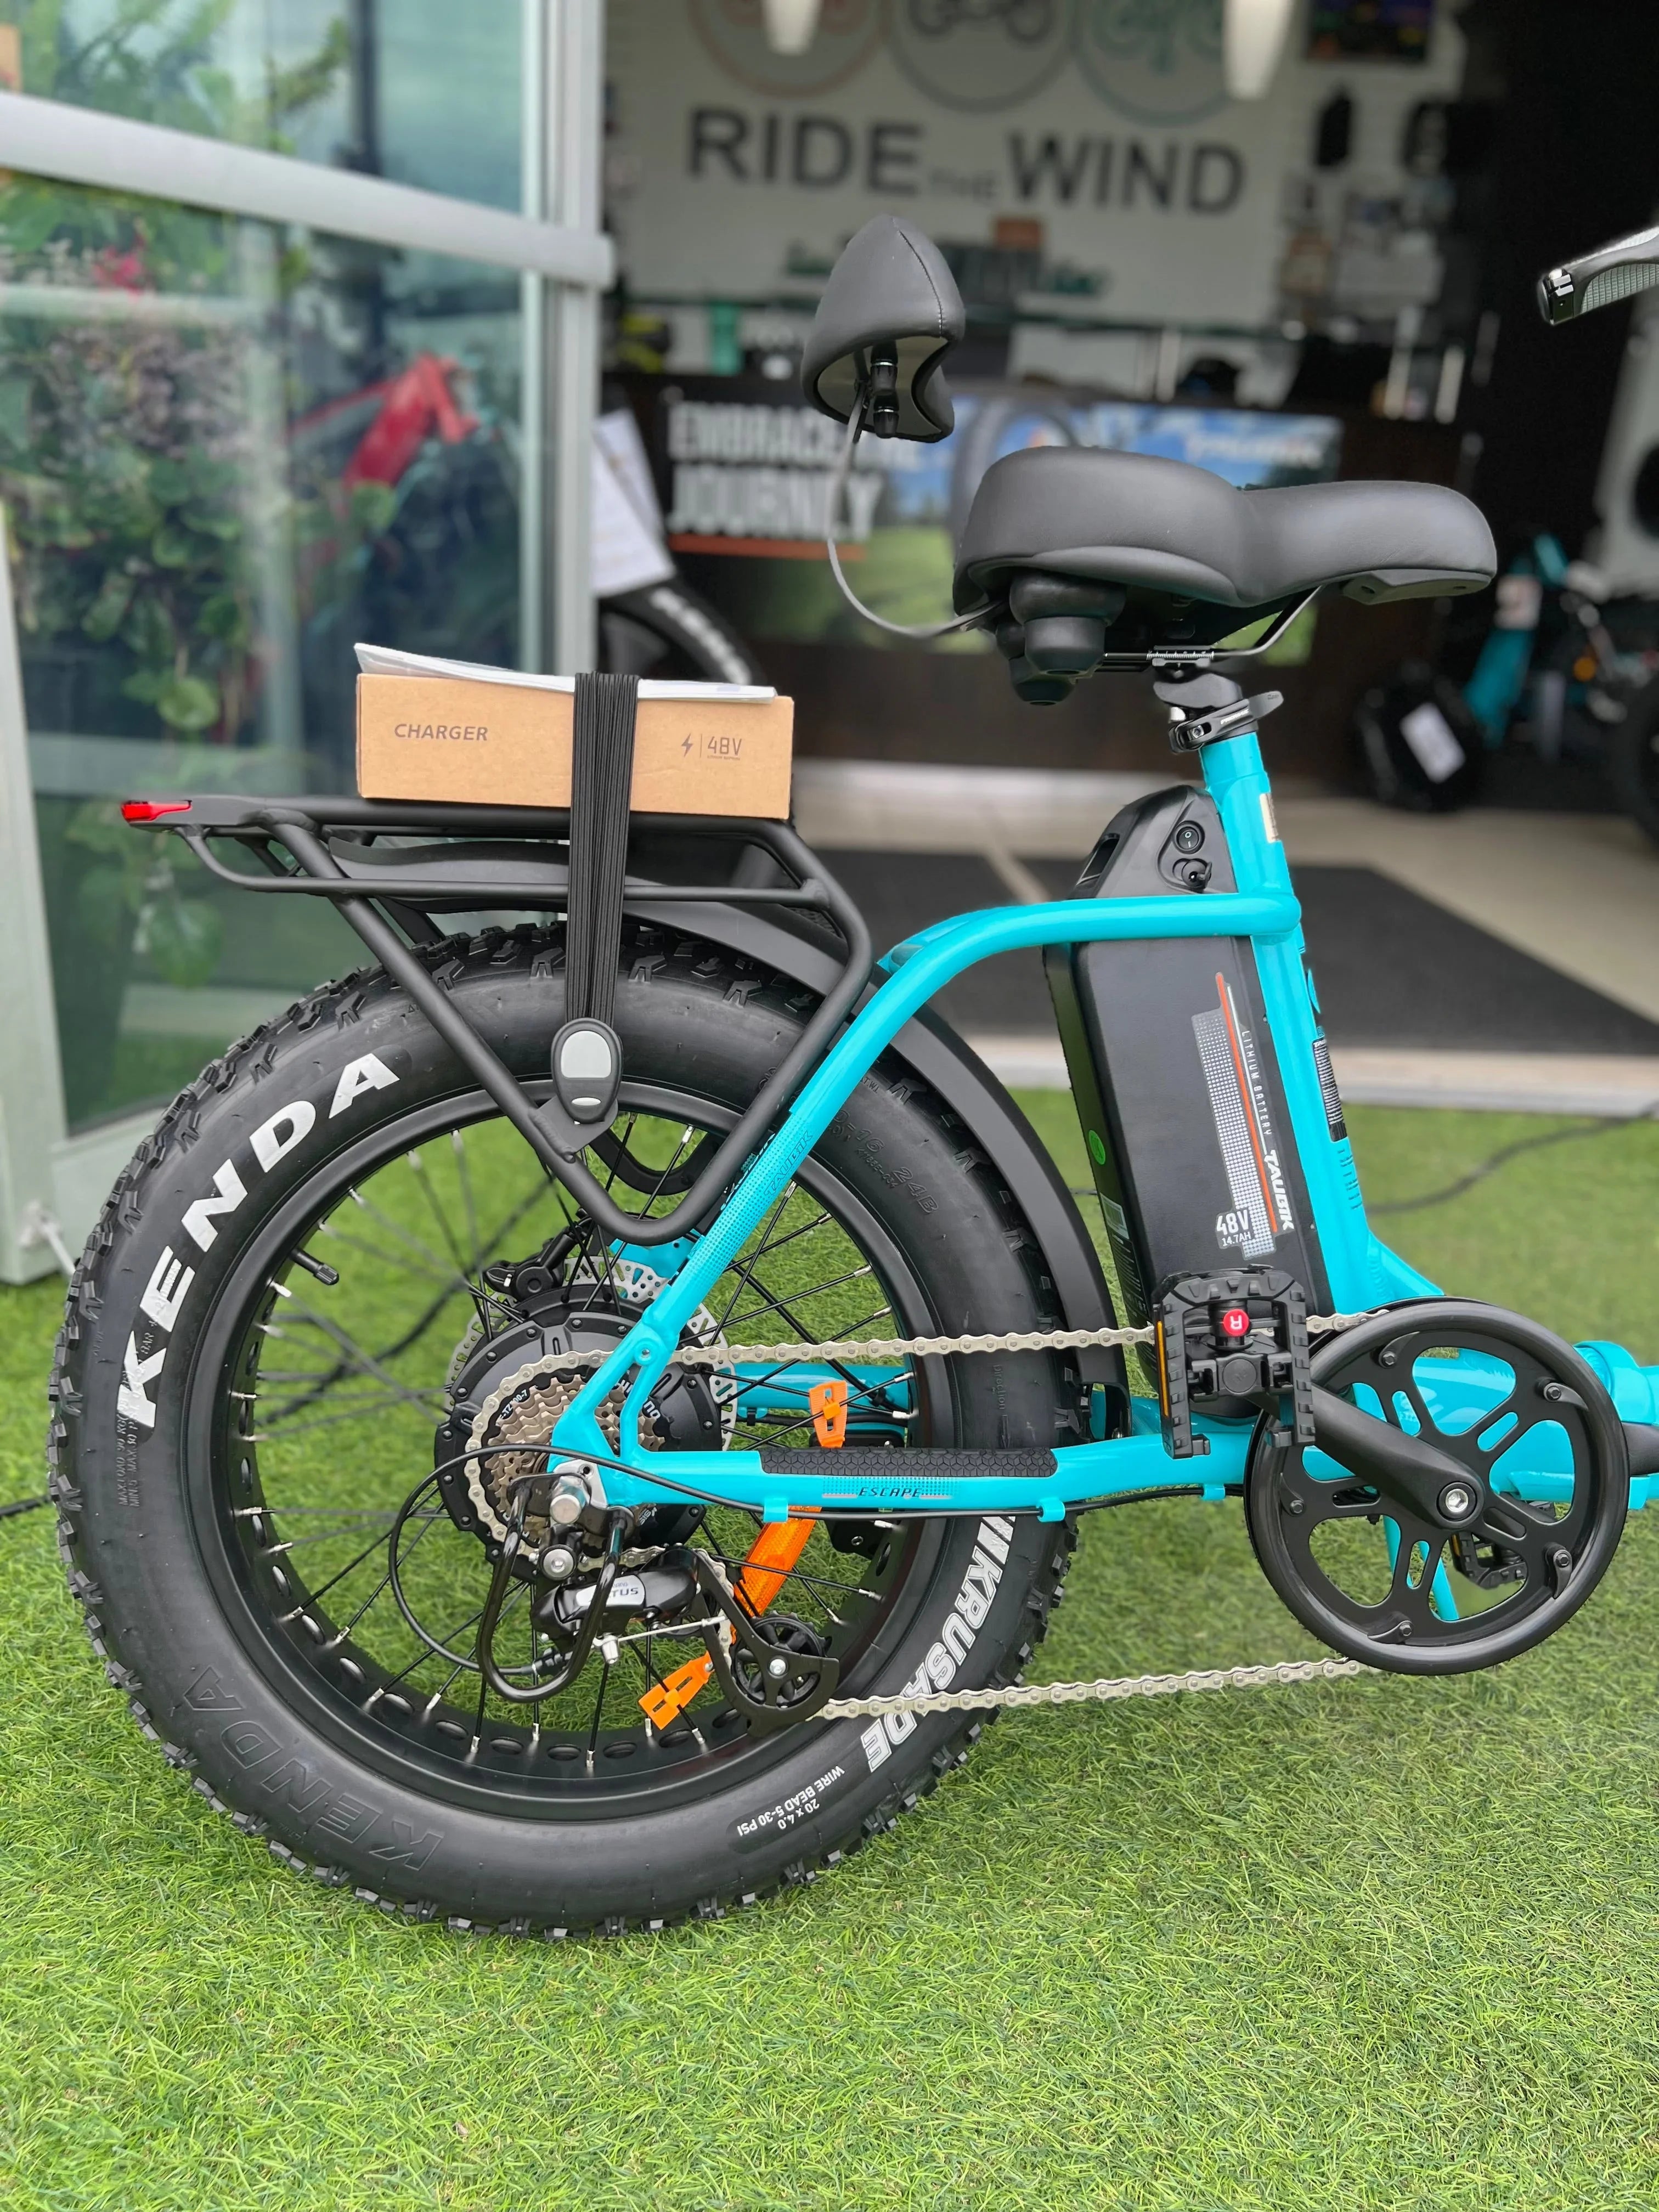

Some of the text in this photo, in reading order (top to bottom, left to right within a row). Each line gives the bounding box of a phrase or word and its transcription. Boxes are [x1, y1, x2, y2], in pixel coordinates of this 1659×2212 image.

[687, 105, 925, 198] RIDE
[1006, 131, 1247, 214] WIND
[394, 724, 742, 755] CHARGER 48V
[1241, 1030, 1272, 1136] LITHIUM BATTERY
[892, 1166, 939, 1214] 24B
[1216, 1209, 1250, 1235] 48V
[117, 1053, 400, 1427] KENDA
[1221, 1231, 1251, 1246] 14.7AH
[1229, 1314, 1243, 1330] R
[858, 1487, 922, 1497] ESCAPE
[611, 1587, 639, 1598] TUS
[183, 1665, 444, 1871] KENDA
[737, 1765, 845, 1837] WIRE BEAD 5-30 PSI
[804, 1798, 820, 1814] 20
[777, 1814, 795, 1830] 4.0
